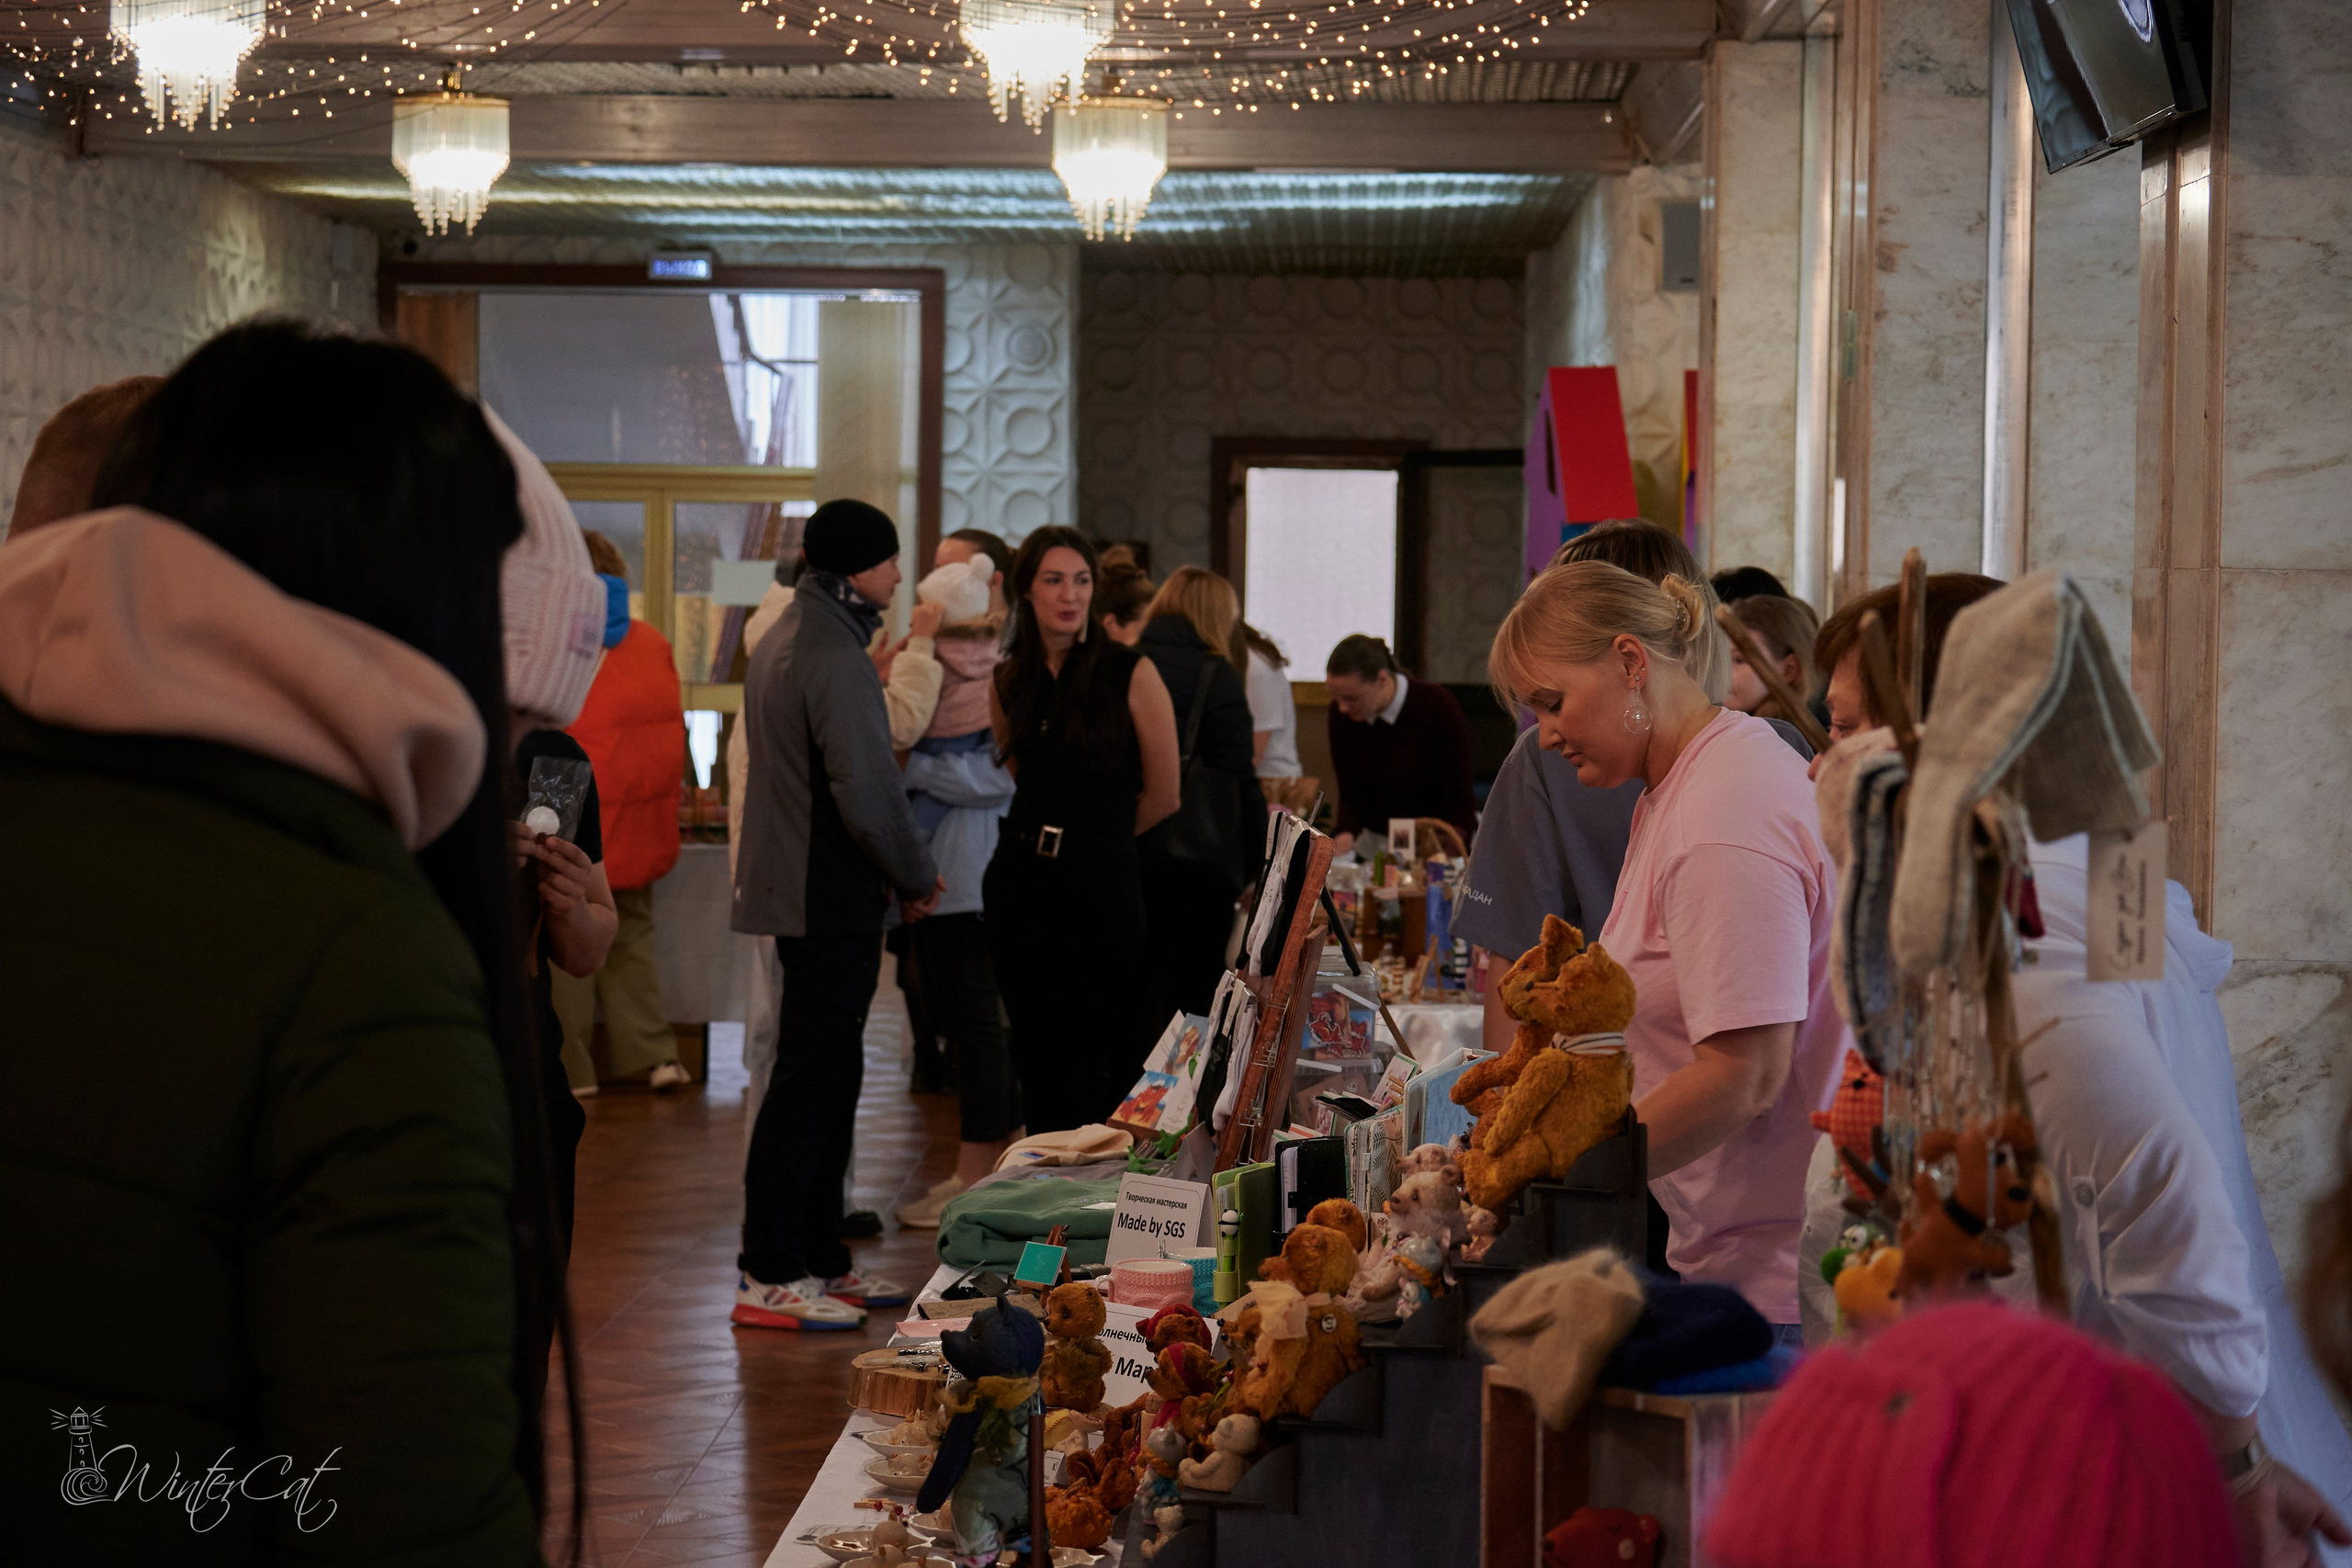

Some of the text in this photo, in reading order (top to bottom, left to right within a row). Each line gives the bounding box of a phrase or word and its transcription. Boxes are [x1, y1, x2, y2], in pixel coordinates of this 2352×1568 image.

[1125, 1191, 1188, 1210] Творческая мастерская
[1117, 1212, 1186, 1238] Made by SGS
